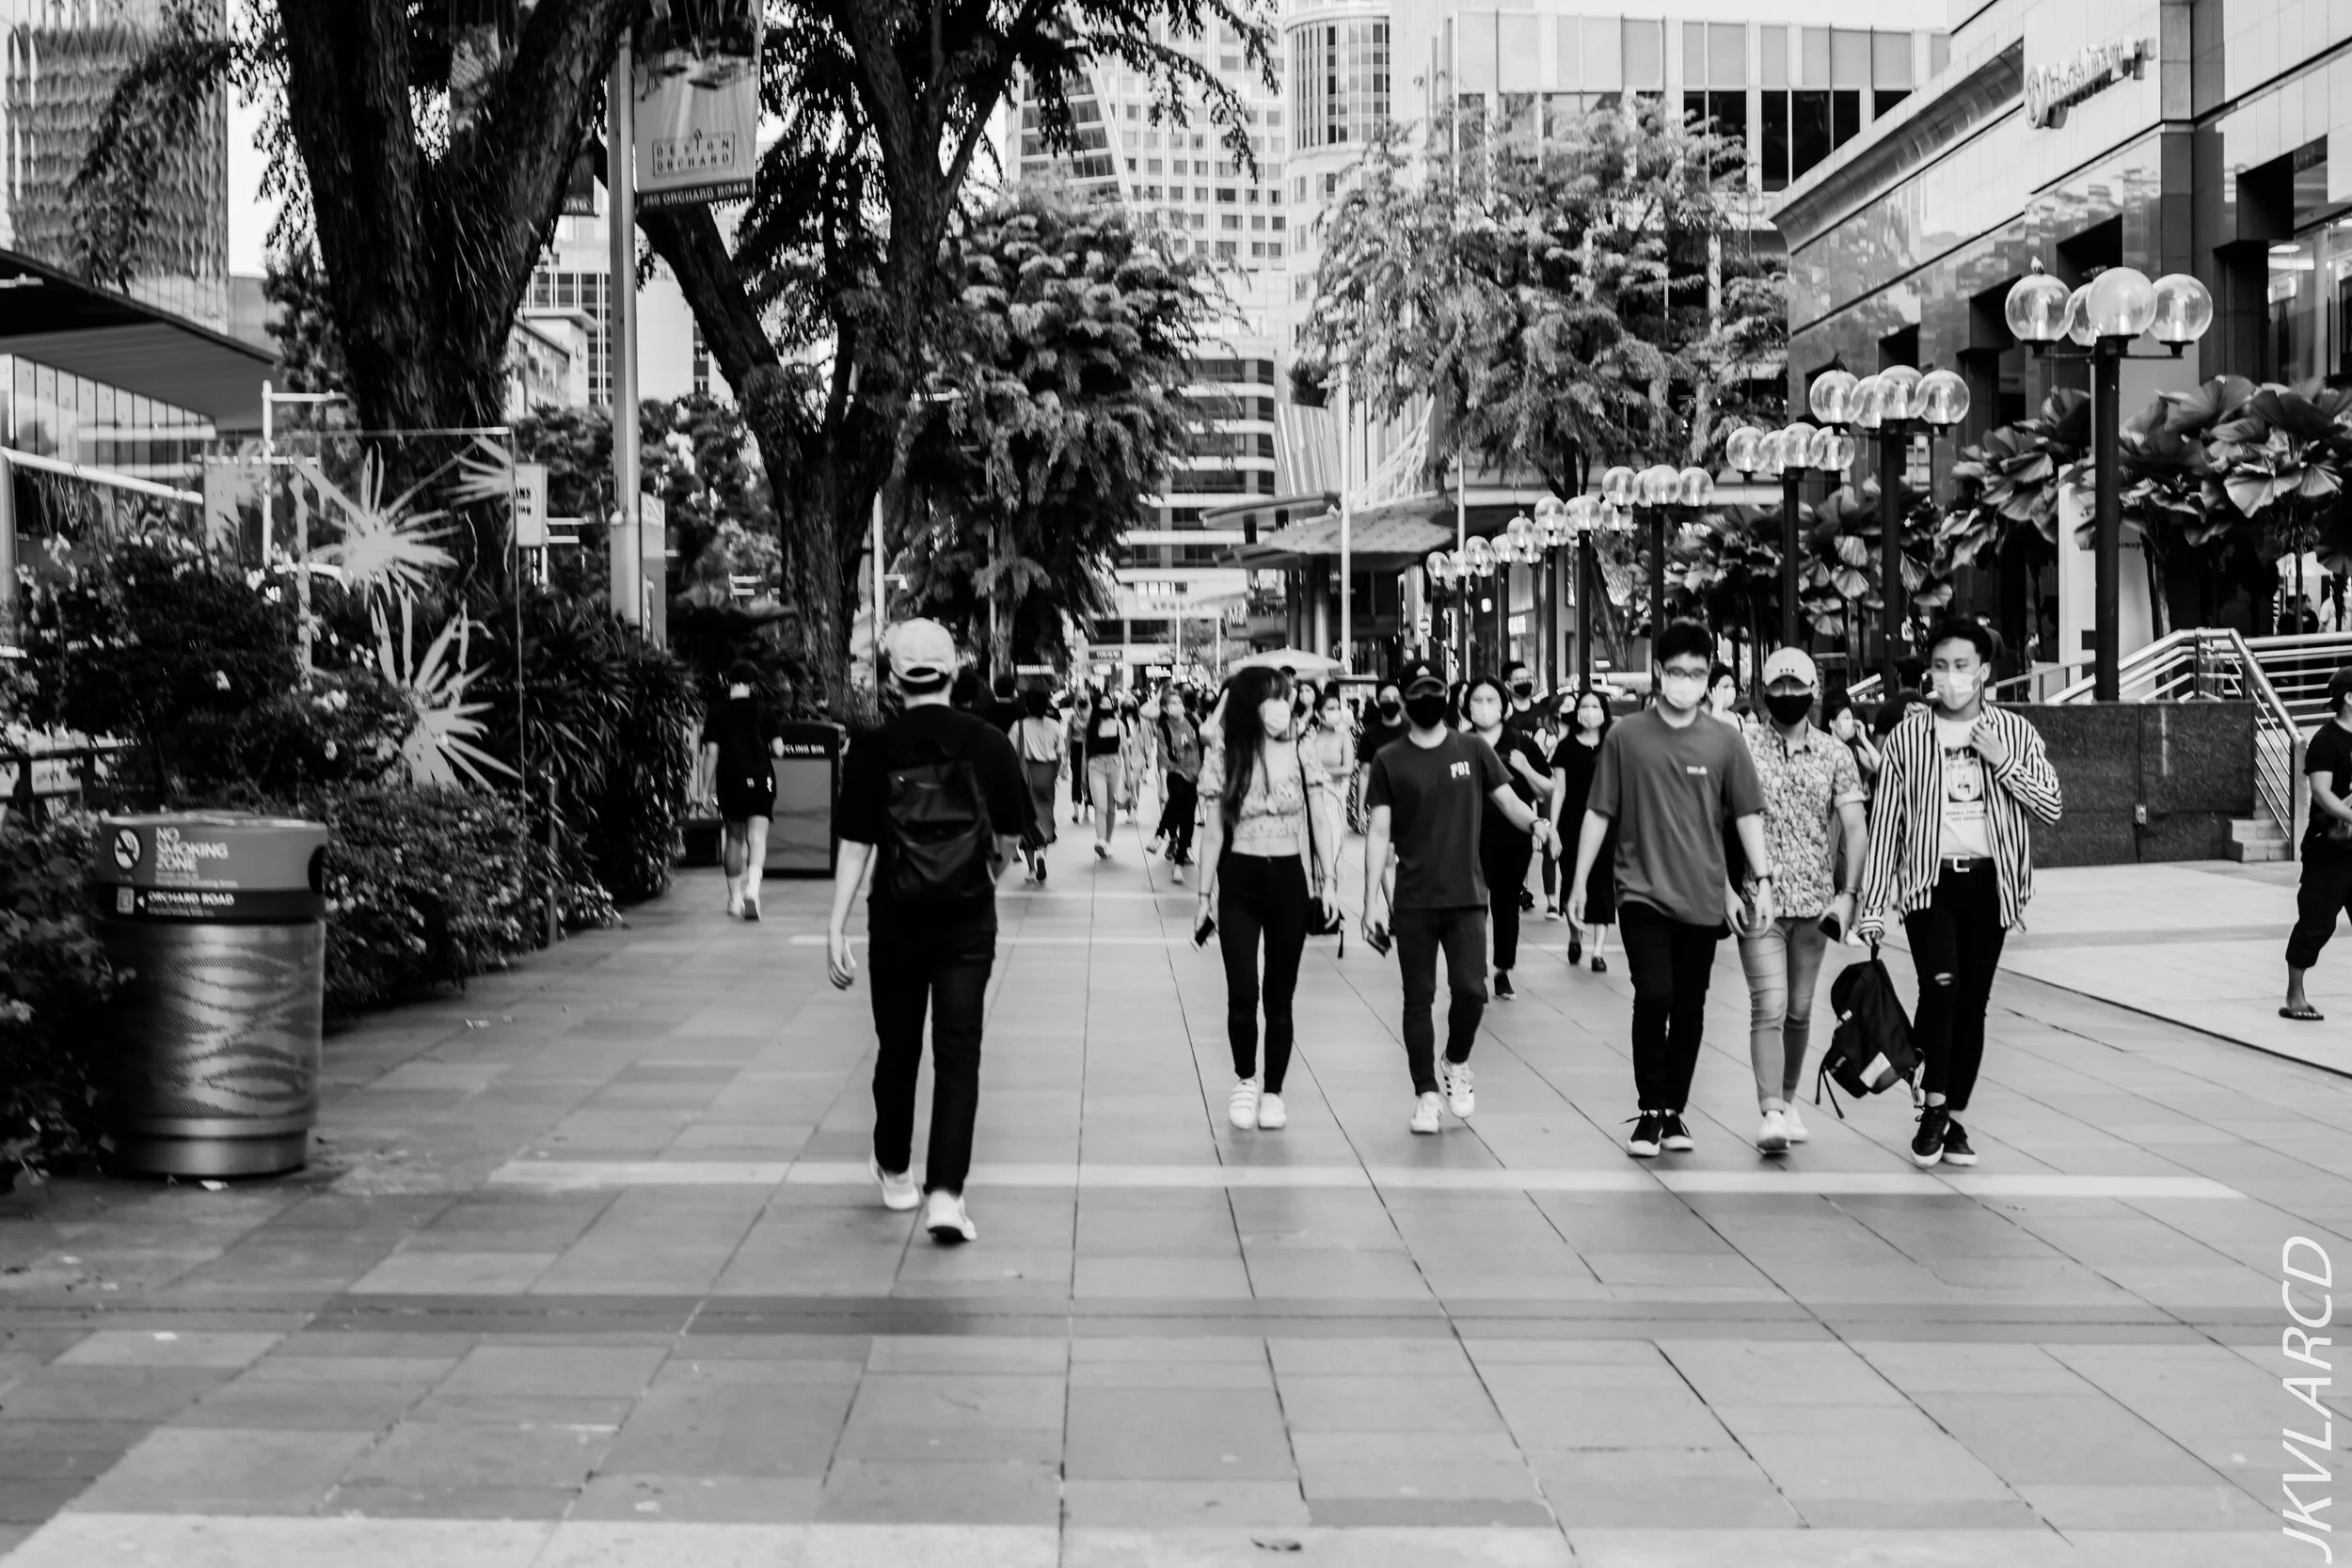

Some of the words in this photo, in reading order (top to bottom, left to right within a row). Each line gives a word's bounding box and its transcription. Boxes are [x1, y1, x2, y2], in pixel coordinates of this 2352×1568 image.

[657, 133, 730, 157] DESIGN
[657, 150, 730, 172] ORCHARD
[662, 185, 715, 205] ORCHARD
[717, 182, 748, 199] ROAD
[810, 744, 825, 755] BIN
[155, 827, 181, 844] NO
[155, 841, 230, 859] SMOKING
[155, 853, 198, 873] ZONE
[147, 890, 199, 905] ORCHARD
[200, 892, 235, 907] ROAD
